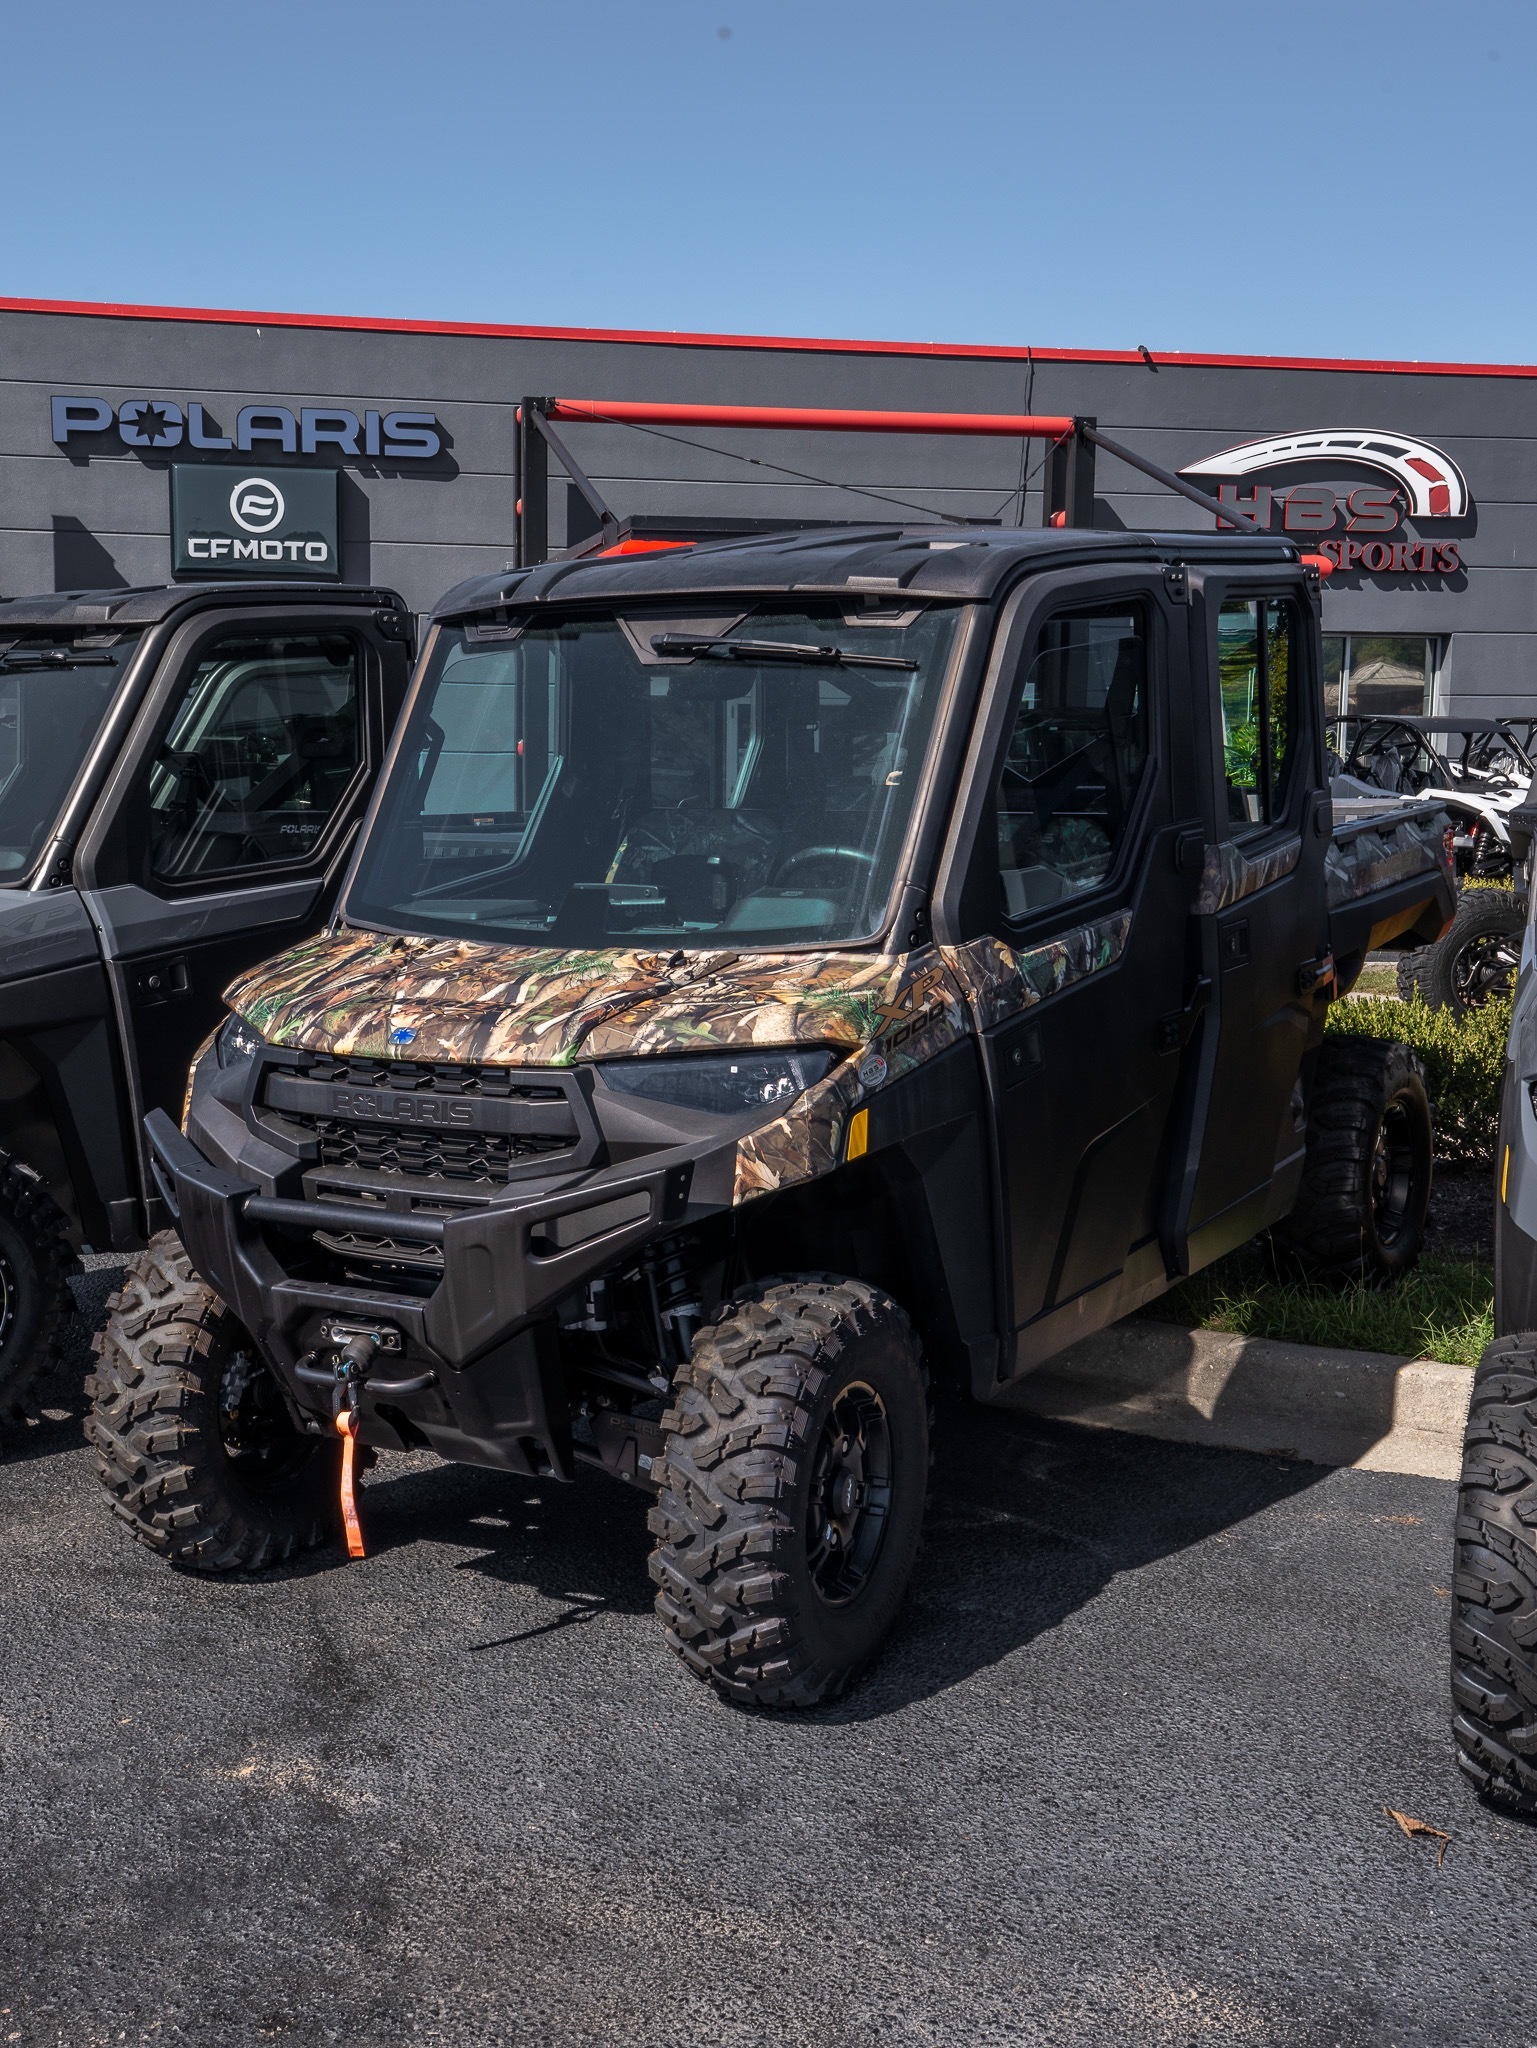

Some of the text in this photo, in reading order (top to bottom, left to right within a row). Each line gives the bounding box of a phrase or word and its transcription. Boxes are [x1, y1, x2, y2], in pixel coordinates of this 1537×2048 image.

[51, 395, 441, 457] POLARIS
[1217, 485, 1400, 531] HBS
[187, 538, 328, 562] CFMOTO
[1317, 540, 1460, 573] SPORTS
[868, 968, 944, 1044] XP
[886, 1001, 944, 1052] 1000
[333, 1090, 474, 1126] POLARIS
